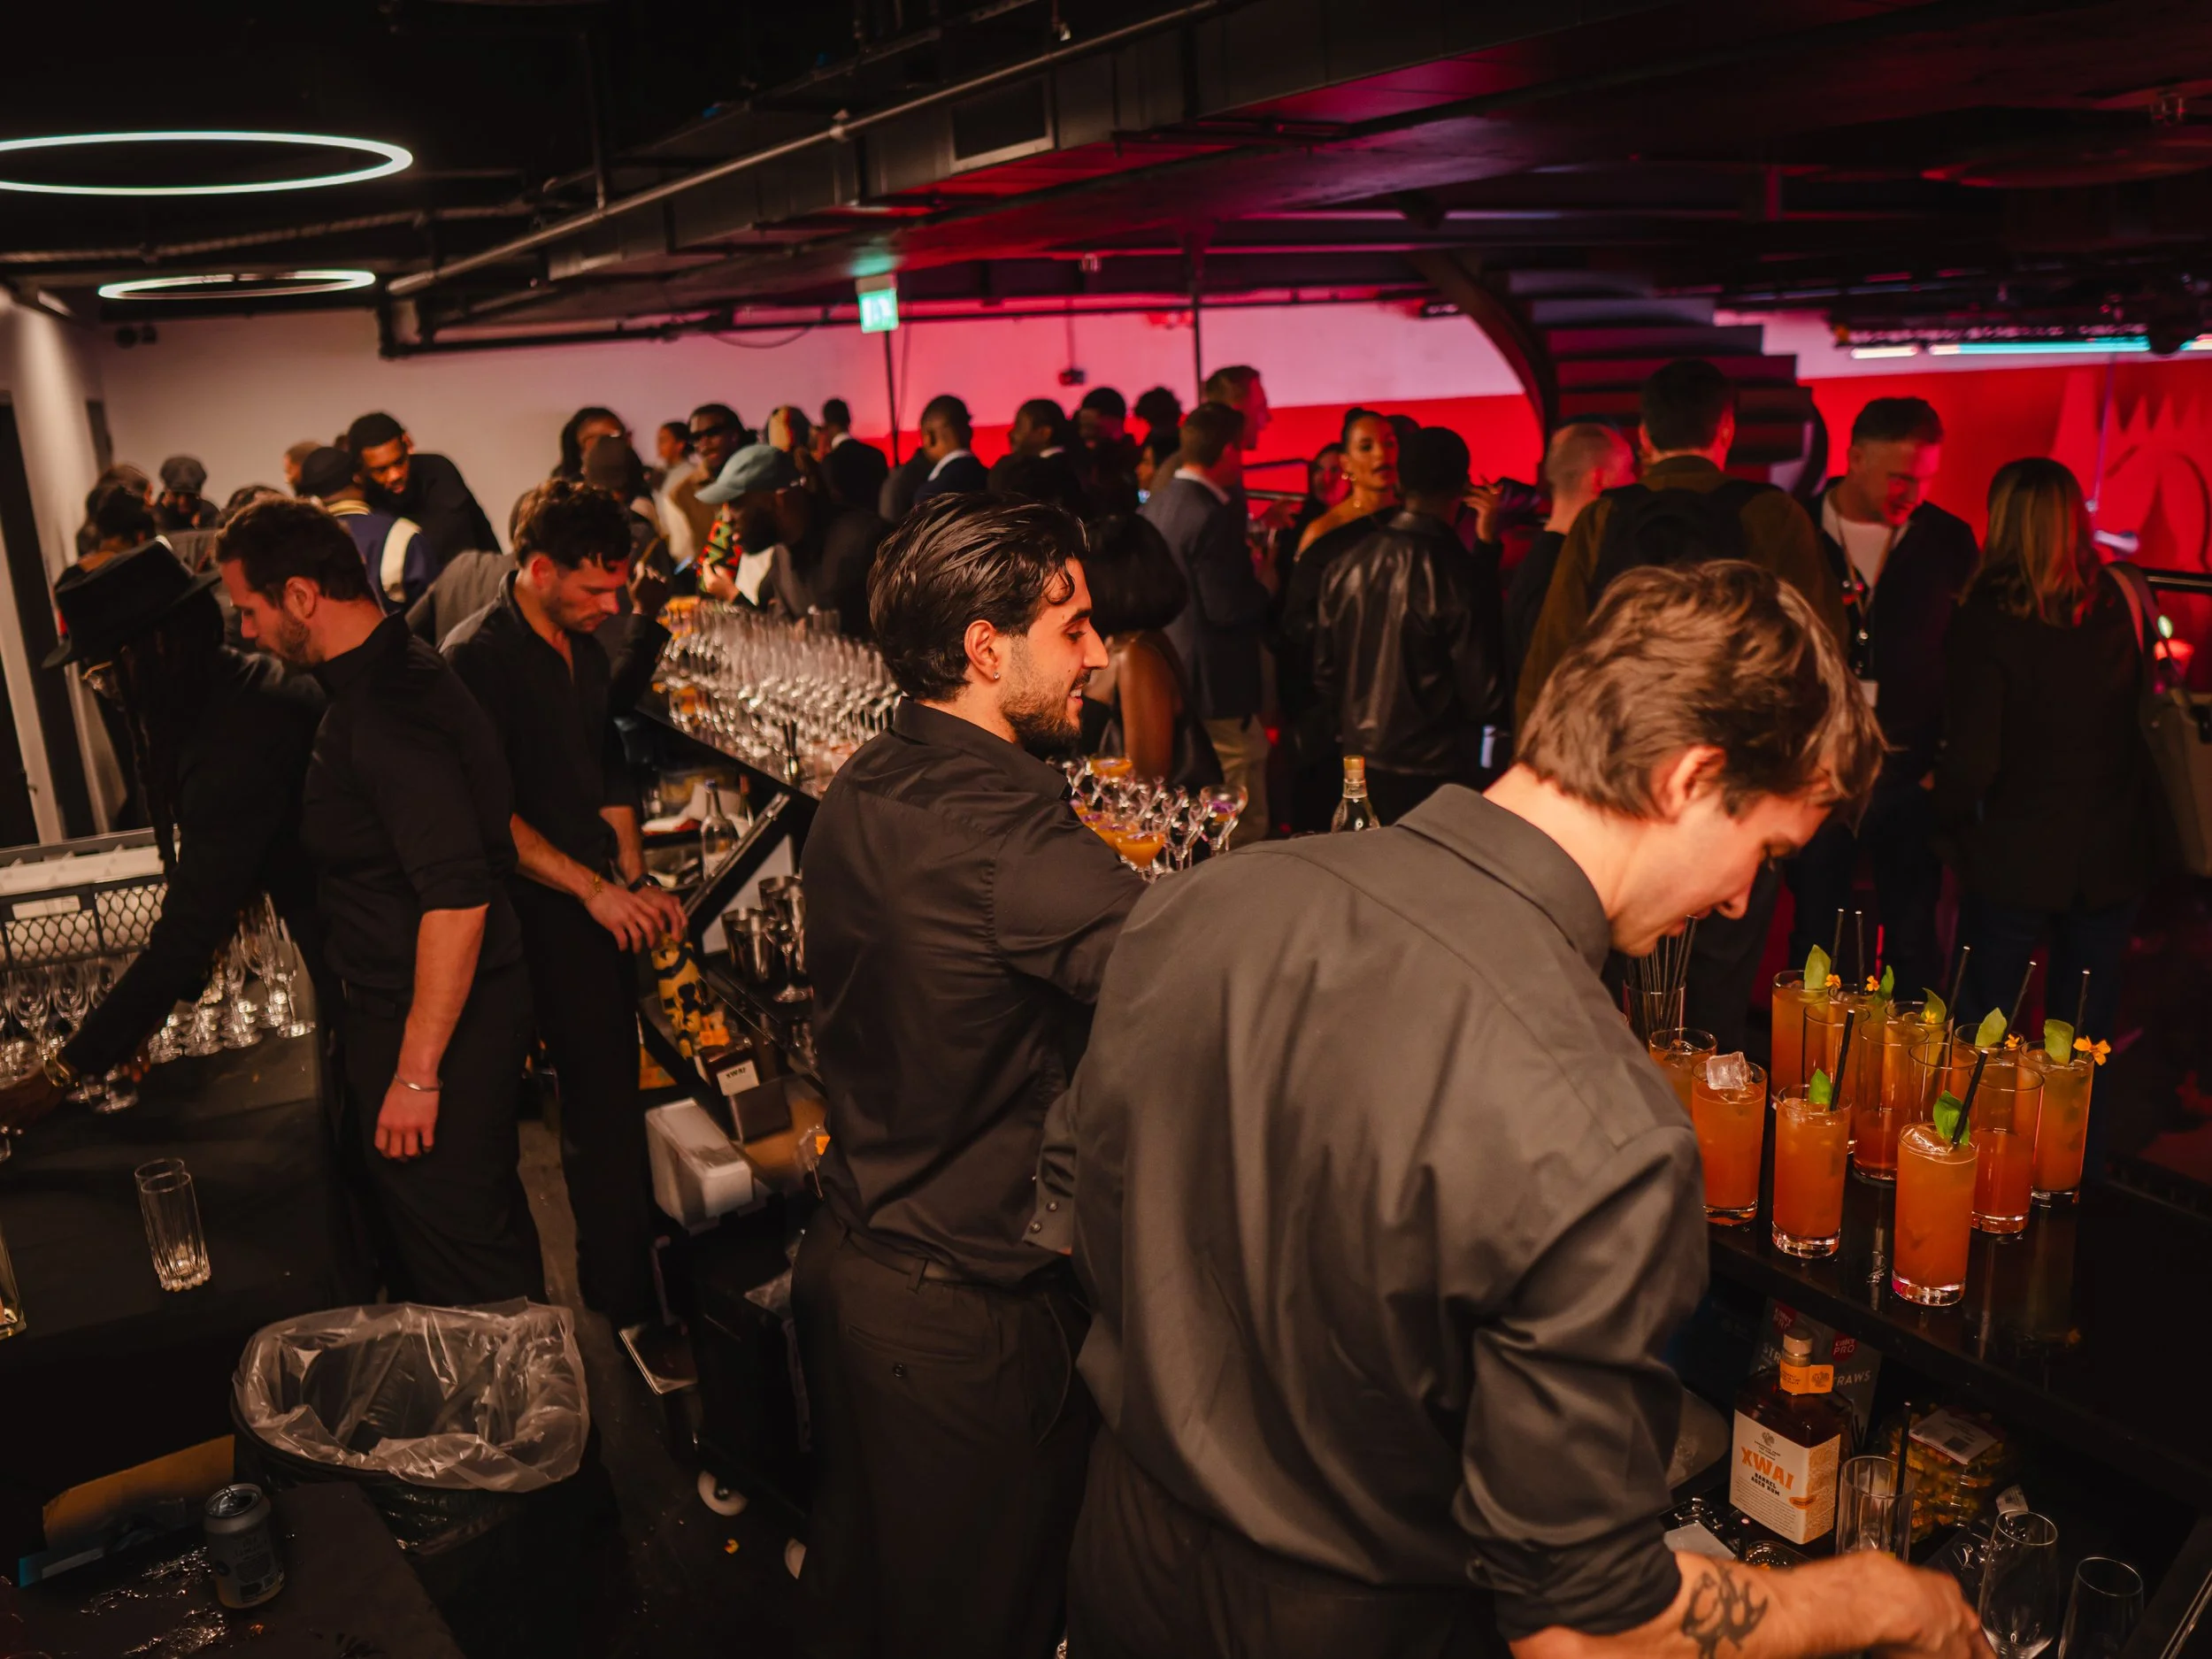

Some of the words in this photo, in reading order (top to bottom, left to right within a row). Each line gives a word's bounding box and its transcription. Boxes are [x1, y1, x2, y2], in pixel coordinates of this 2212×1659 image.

[1763, 1341, 1782, 1363] STR
[1832, 1344, 1855, 1356] PRO
[1834, 1371, 1871, 1386] RAWS
[1740, 1446, 1794, 1490] XWAI
[1751, 1477, 1766, 1488] AGED
[1767, 1486, 1780, 1496] RUM
[1755, 1472, 1777, 1489] BARREL
